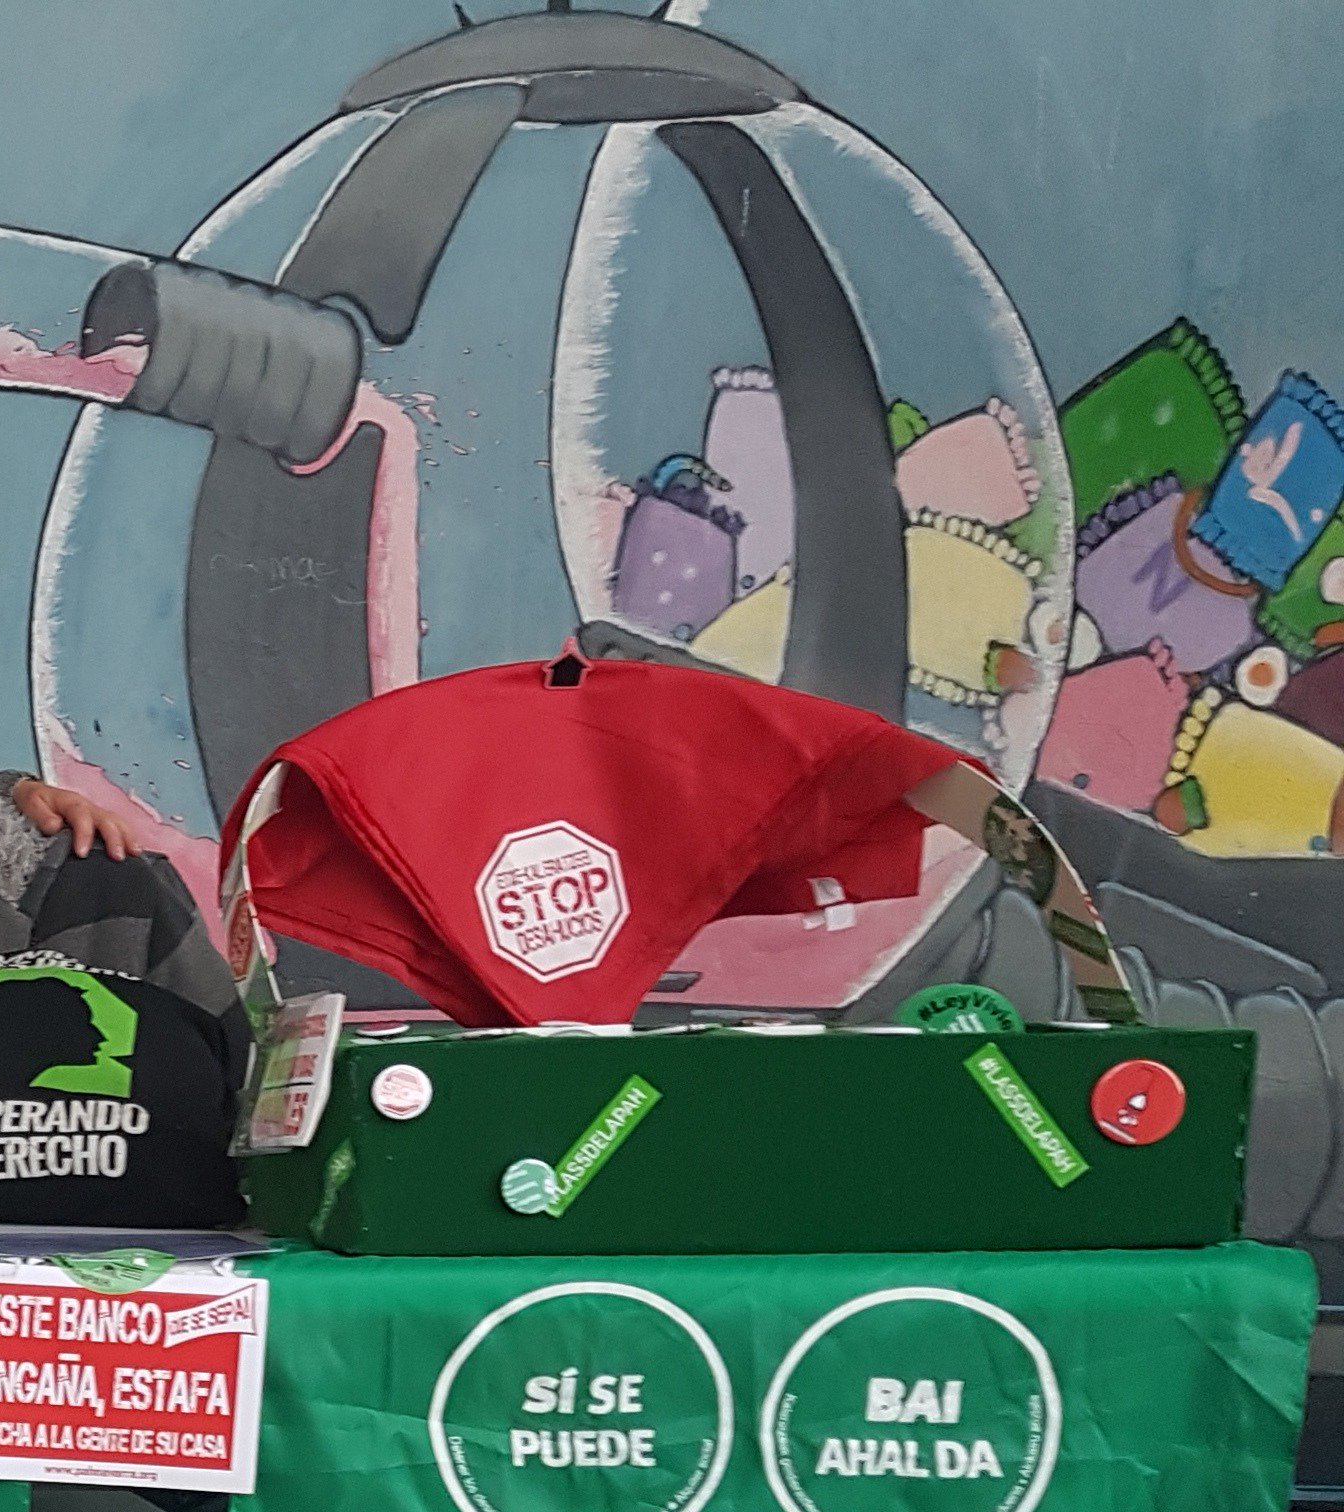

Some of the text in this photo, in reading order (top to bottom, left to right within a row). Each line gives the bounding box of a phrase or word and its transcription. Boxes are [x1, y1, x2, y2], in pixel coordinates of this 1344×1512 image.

[496, 866, 609, 931] STOP
[58, 1296, 162, 1345] BANCO
[112, 1366, 231, 1417] ESTAFA
[522, 1366, 644, 1416] SÍ SE
[865, 1377, 964, 1425] BAI
[33, 1422, 50, 1449] A
[50, 1423, 75, 1450] LA
[76, 1426, 130, 1453] GENTE
[131, 1429, 155, 1455] DE
[155, 1430, 180, 1456] SU
[180, 1432, 228, 1460] CASA
[510, 1428, 657, 1469] PUEDE
[814, 1436, 1004, 1480] AHAL DA
